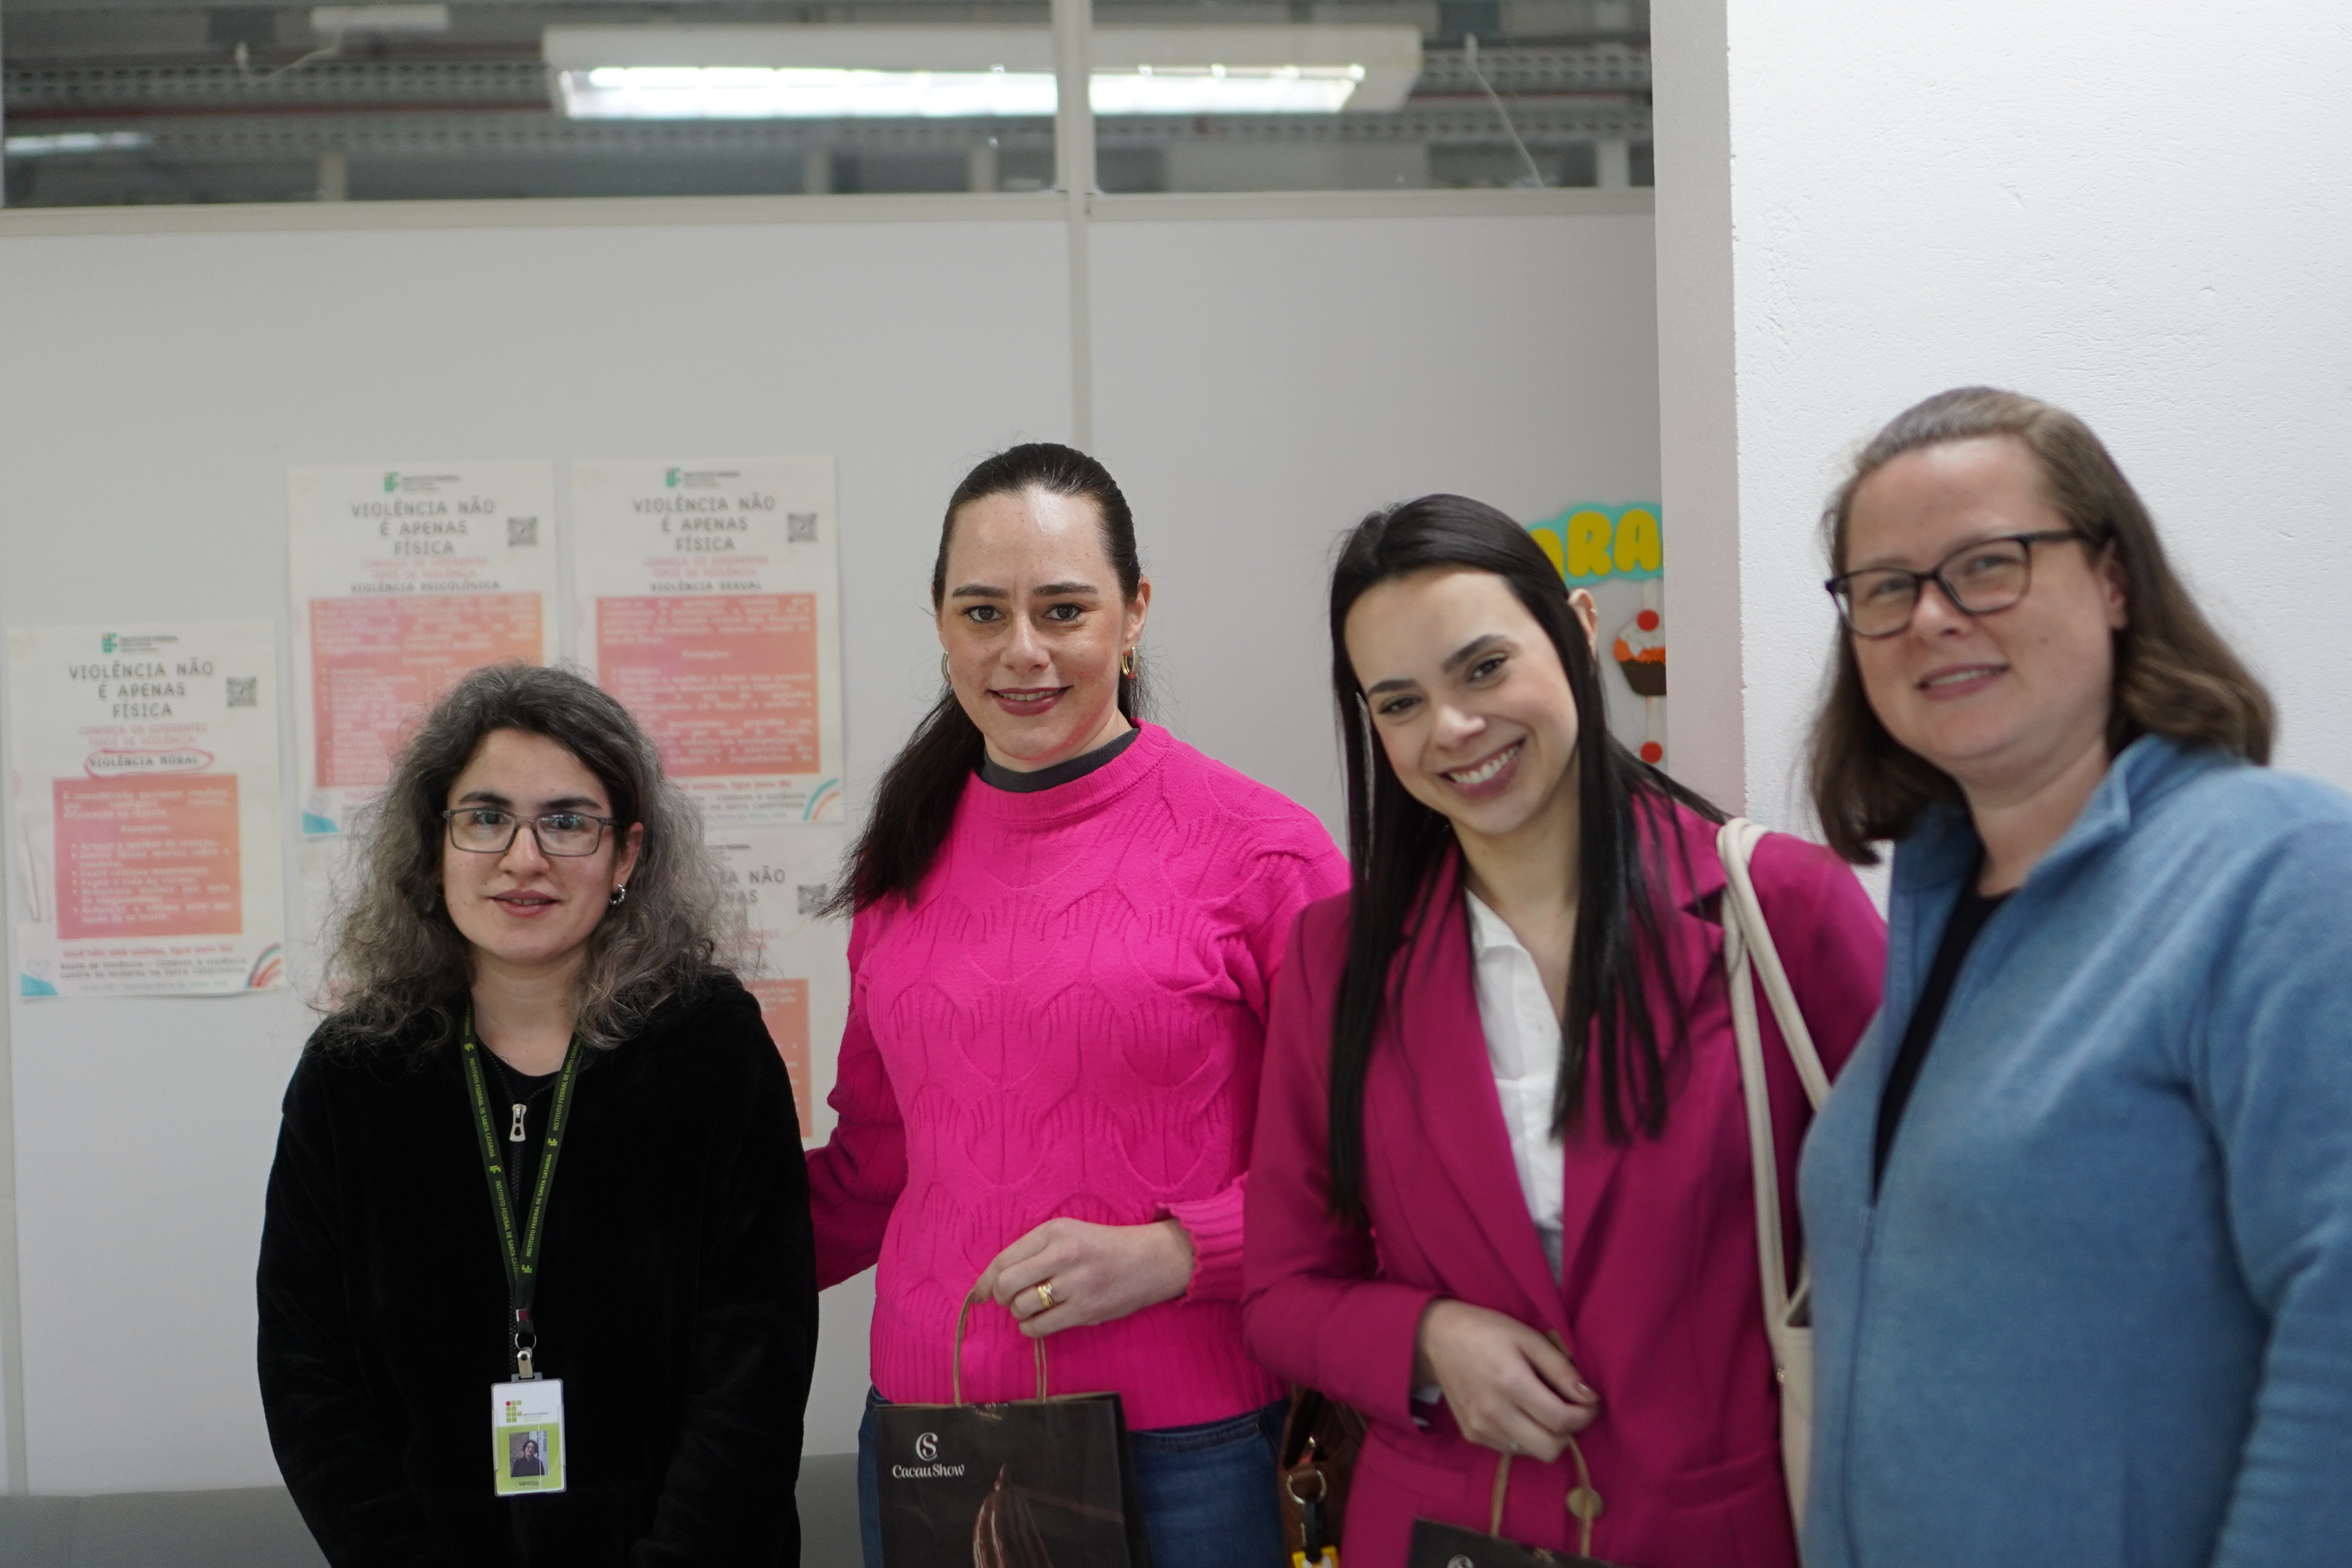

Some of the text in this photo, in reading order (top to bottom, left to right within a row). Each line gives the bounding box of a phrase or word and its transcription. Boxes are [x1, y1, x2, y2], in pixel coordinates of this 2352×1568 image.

[351, 495, 495, 517] VIOLÊNCIA NÃO
[633, 492, 776, 513] VIOLÊNCIA NÃO
[399, 519, 467, 535] APENAS
[681, 516, 748, 532] APENAS
[394, 538, 455, 555] FÍSICA
[675, 534, 736, 552] FÍSICA
[69, 656, 213, 680] VIOLÊNCIA NÃO
[98, 680, 186, 699] É APENAS
[112, 701, 174, 719] FÍSICA
[89, 754, 200, 768] VIOLÊNCIA MORAL
[749, 865, 786, 884] NÃO
[558, 1080, 568, 1104] FEDERAL
[553, 1103, 564, 1131] INSTITUTO
[495, 1180, 506, 1206] INSTITUTO
[501, 1207, 511, 1231] FEDERAL
[508, 1239, 516, 1257] SANTA
[526, 1229, 536, 1257] INSTITUTO
[531, 1206, 540, 1229] FEDERAL
[892, 1463, 965, 1479] Cacau Show
